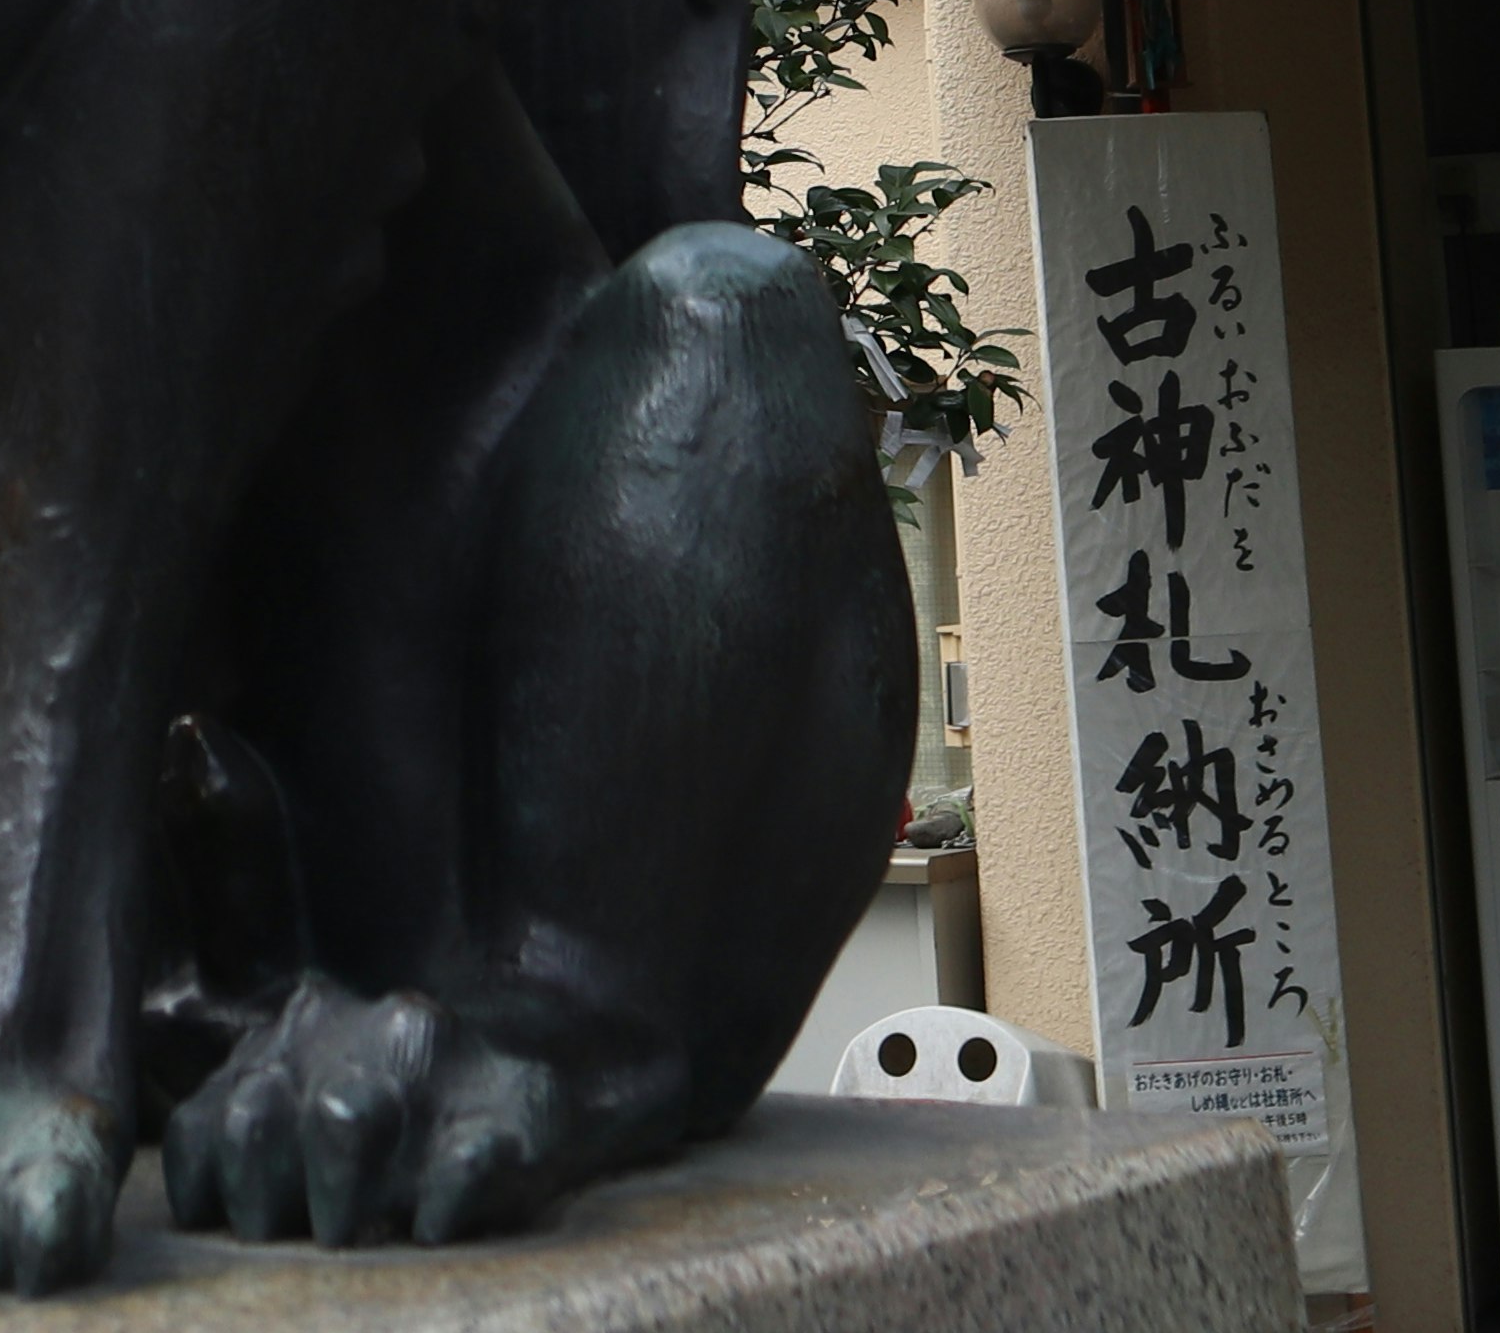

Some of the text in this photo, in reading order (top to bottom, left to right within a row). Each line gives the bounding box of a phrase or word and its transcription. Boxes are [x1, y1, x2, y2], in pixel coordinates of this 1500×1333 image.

[1084, 204, 1257, 1047] 古神札納所
[1134, 1064, 1294, 1092] おたきあげのお守り・お札・
[1191, 1087, 1317, 1113] しめ縄などは社務所へ
